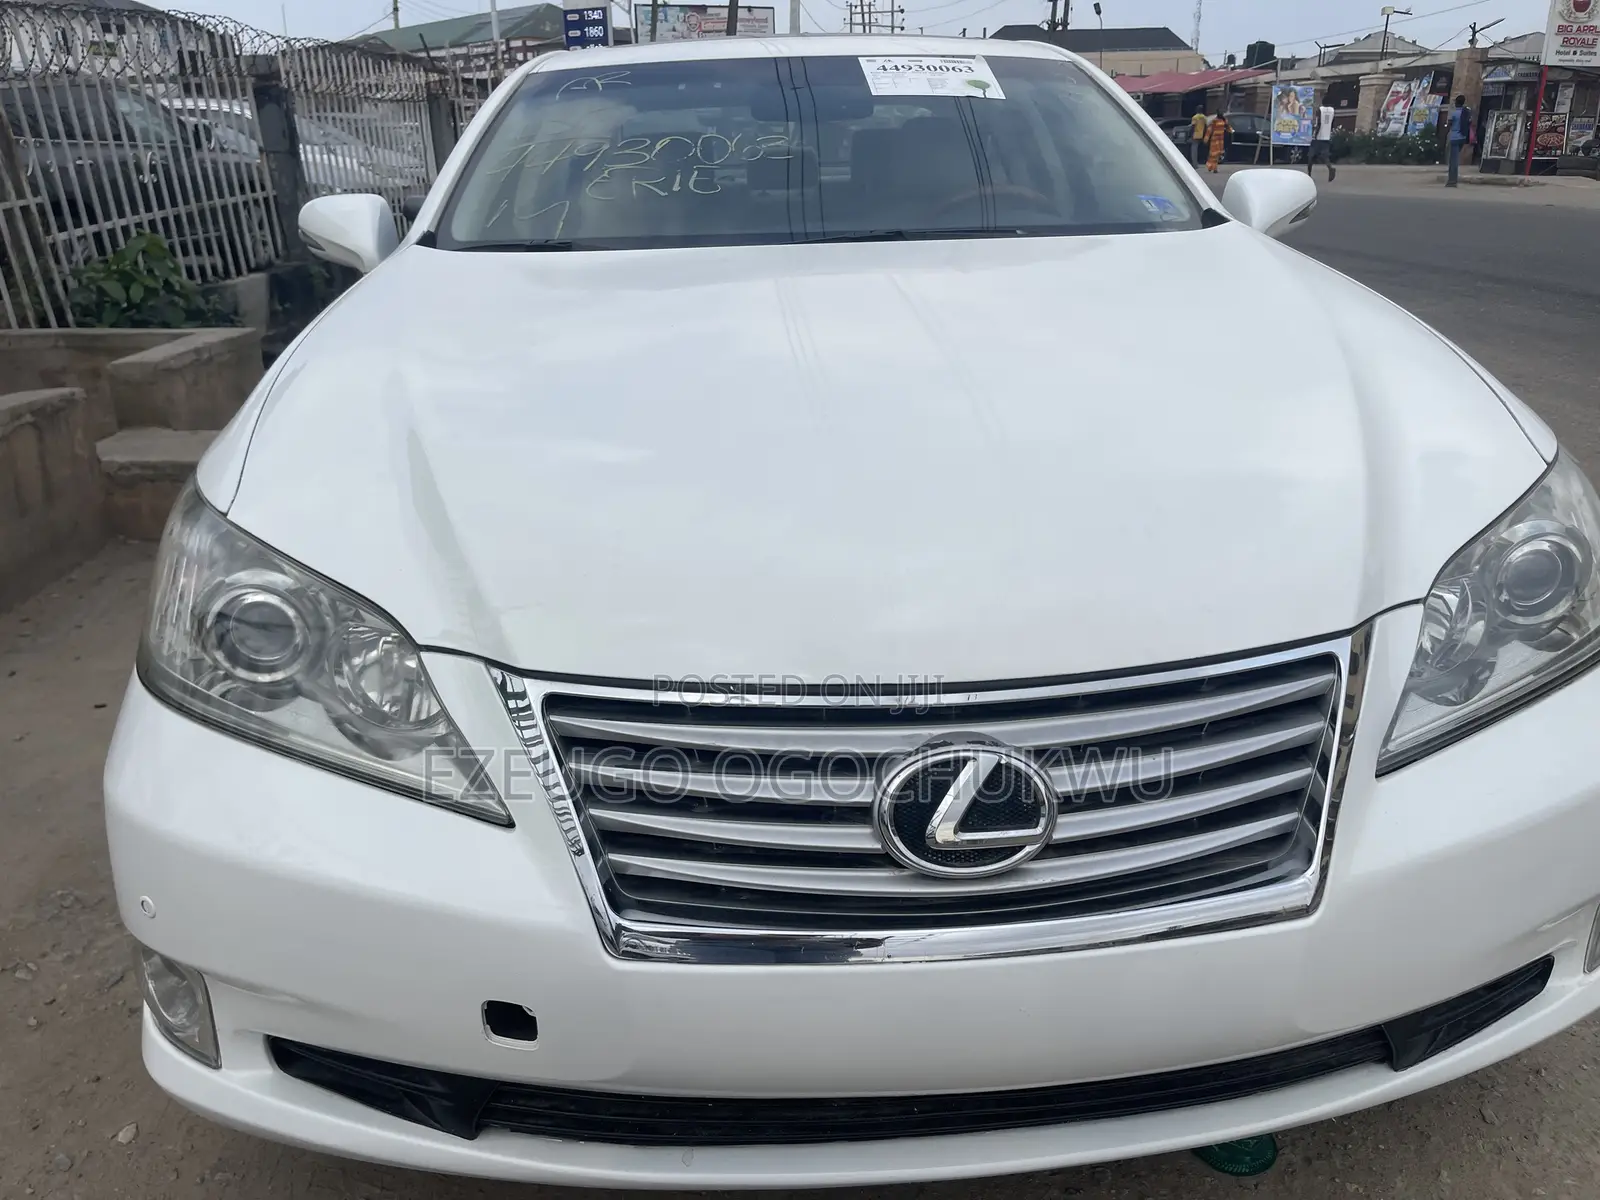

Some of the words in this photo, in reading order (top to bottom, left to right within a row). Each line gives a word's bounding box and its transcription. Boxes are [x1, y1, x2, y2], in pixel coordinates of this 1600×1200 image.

[1557, 25, 1573, 33] BIG
[1576, 25, 1600, 34] APPL
[1562, 37, 1598, 46] ROYALE
[876, 64, 975, 74] 44930063
